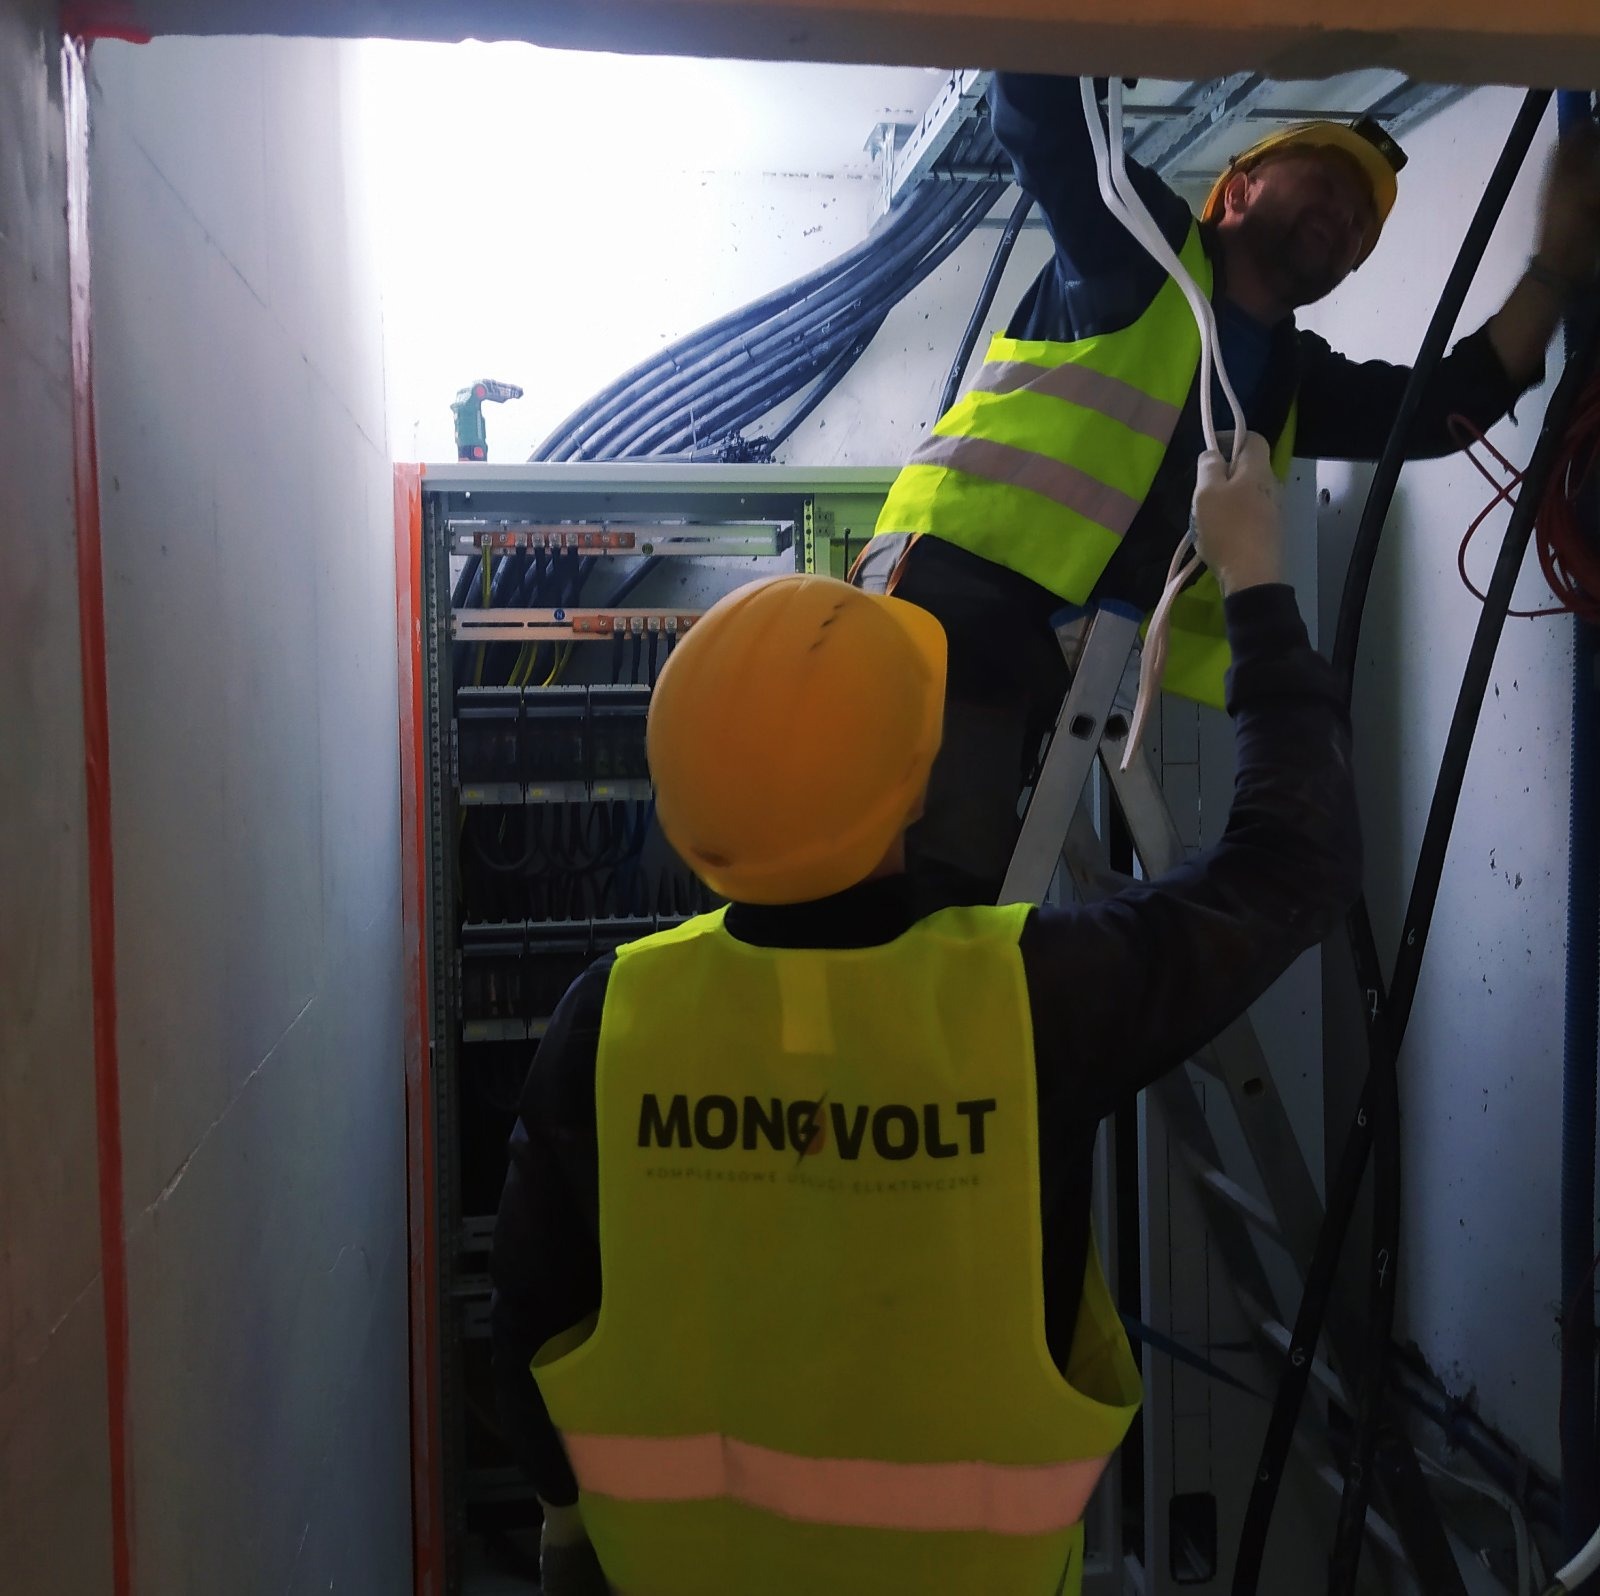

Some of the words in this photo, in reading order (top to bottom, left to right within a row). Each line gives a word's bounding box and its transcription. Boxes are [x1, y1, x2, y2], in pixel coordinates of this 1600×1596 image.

[1406, 928, 1415, 945] 6
[1367, 988, 1380, 1022] 7
[637, 1092, 997, 1162] MONOVOLT
[1357, 1107, 1367, 1126] 6
